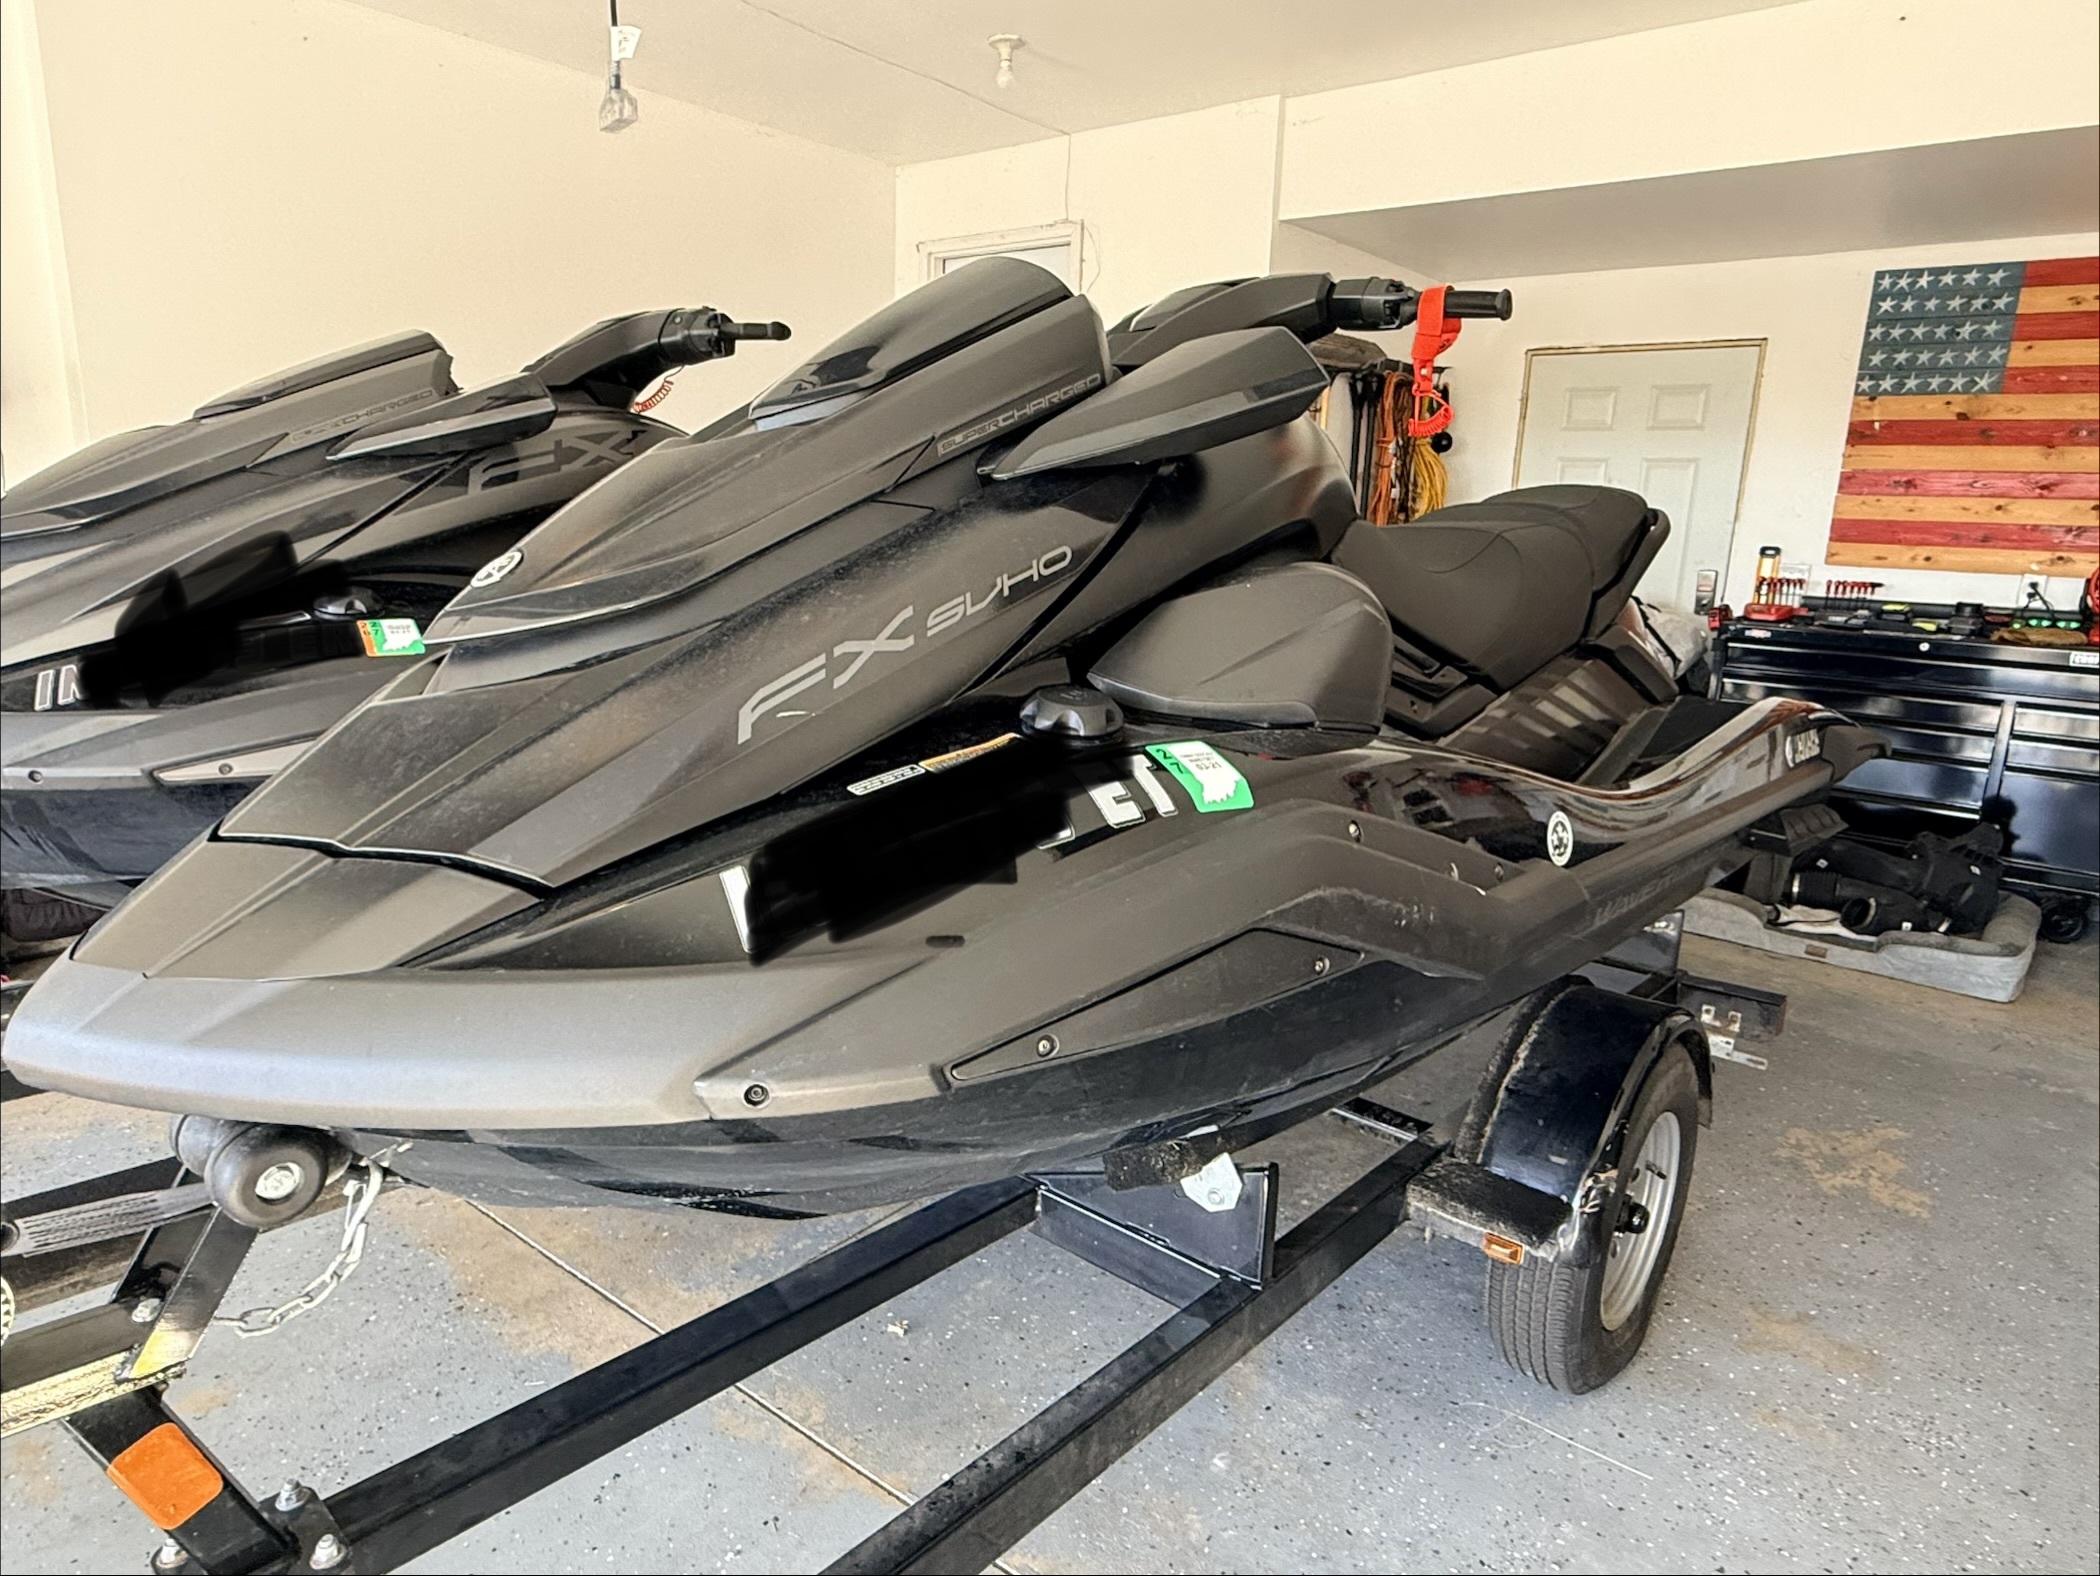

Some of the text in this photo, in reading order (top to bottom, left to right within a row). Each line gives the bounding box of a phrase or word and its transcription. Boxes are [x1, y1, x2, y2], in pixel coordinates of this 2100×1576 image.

[938, 372, 1101, 455] SUPERCHARGED
[738, 545, 1073, 744] FX SVHO
